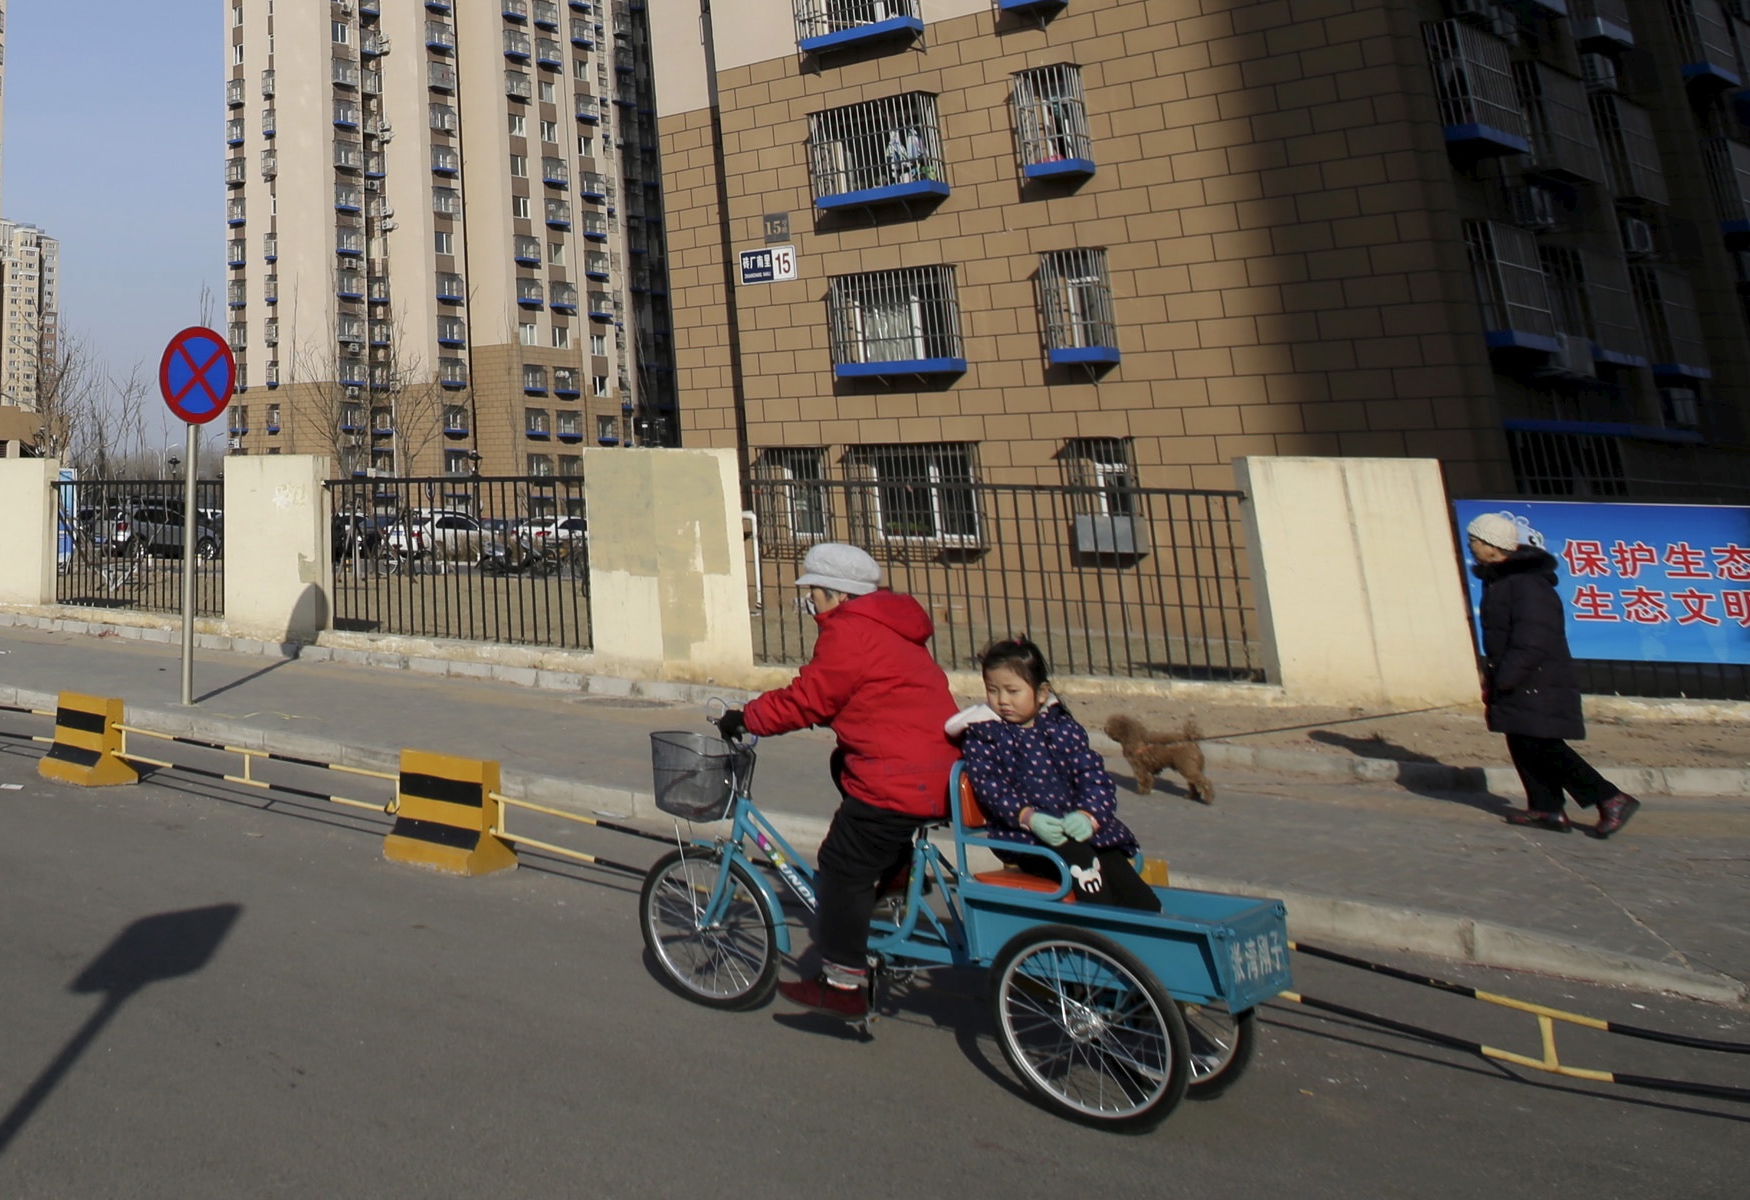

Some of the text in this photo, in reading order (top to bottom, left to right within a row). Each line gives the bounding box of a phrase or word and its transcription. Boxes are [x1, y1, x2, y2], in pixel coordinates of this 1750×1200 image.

[765, 221, 781, 235] 15
[775, 252, 791, 275] 15
[1561, 539, 1750, 581] 保护生态
